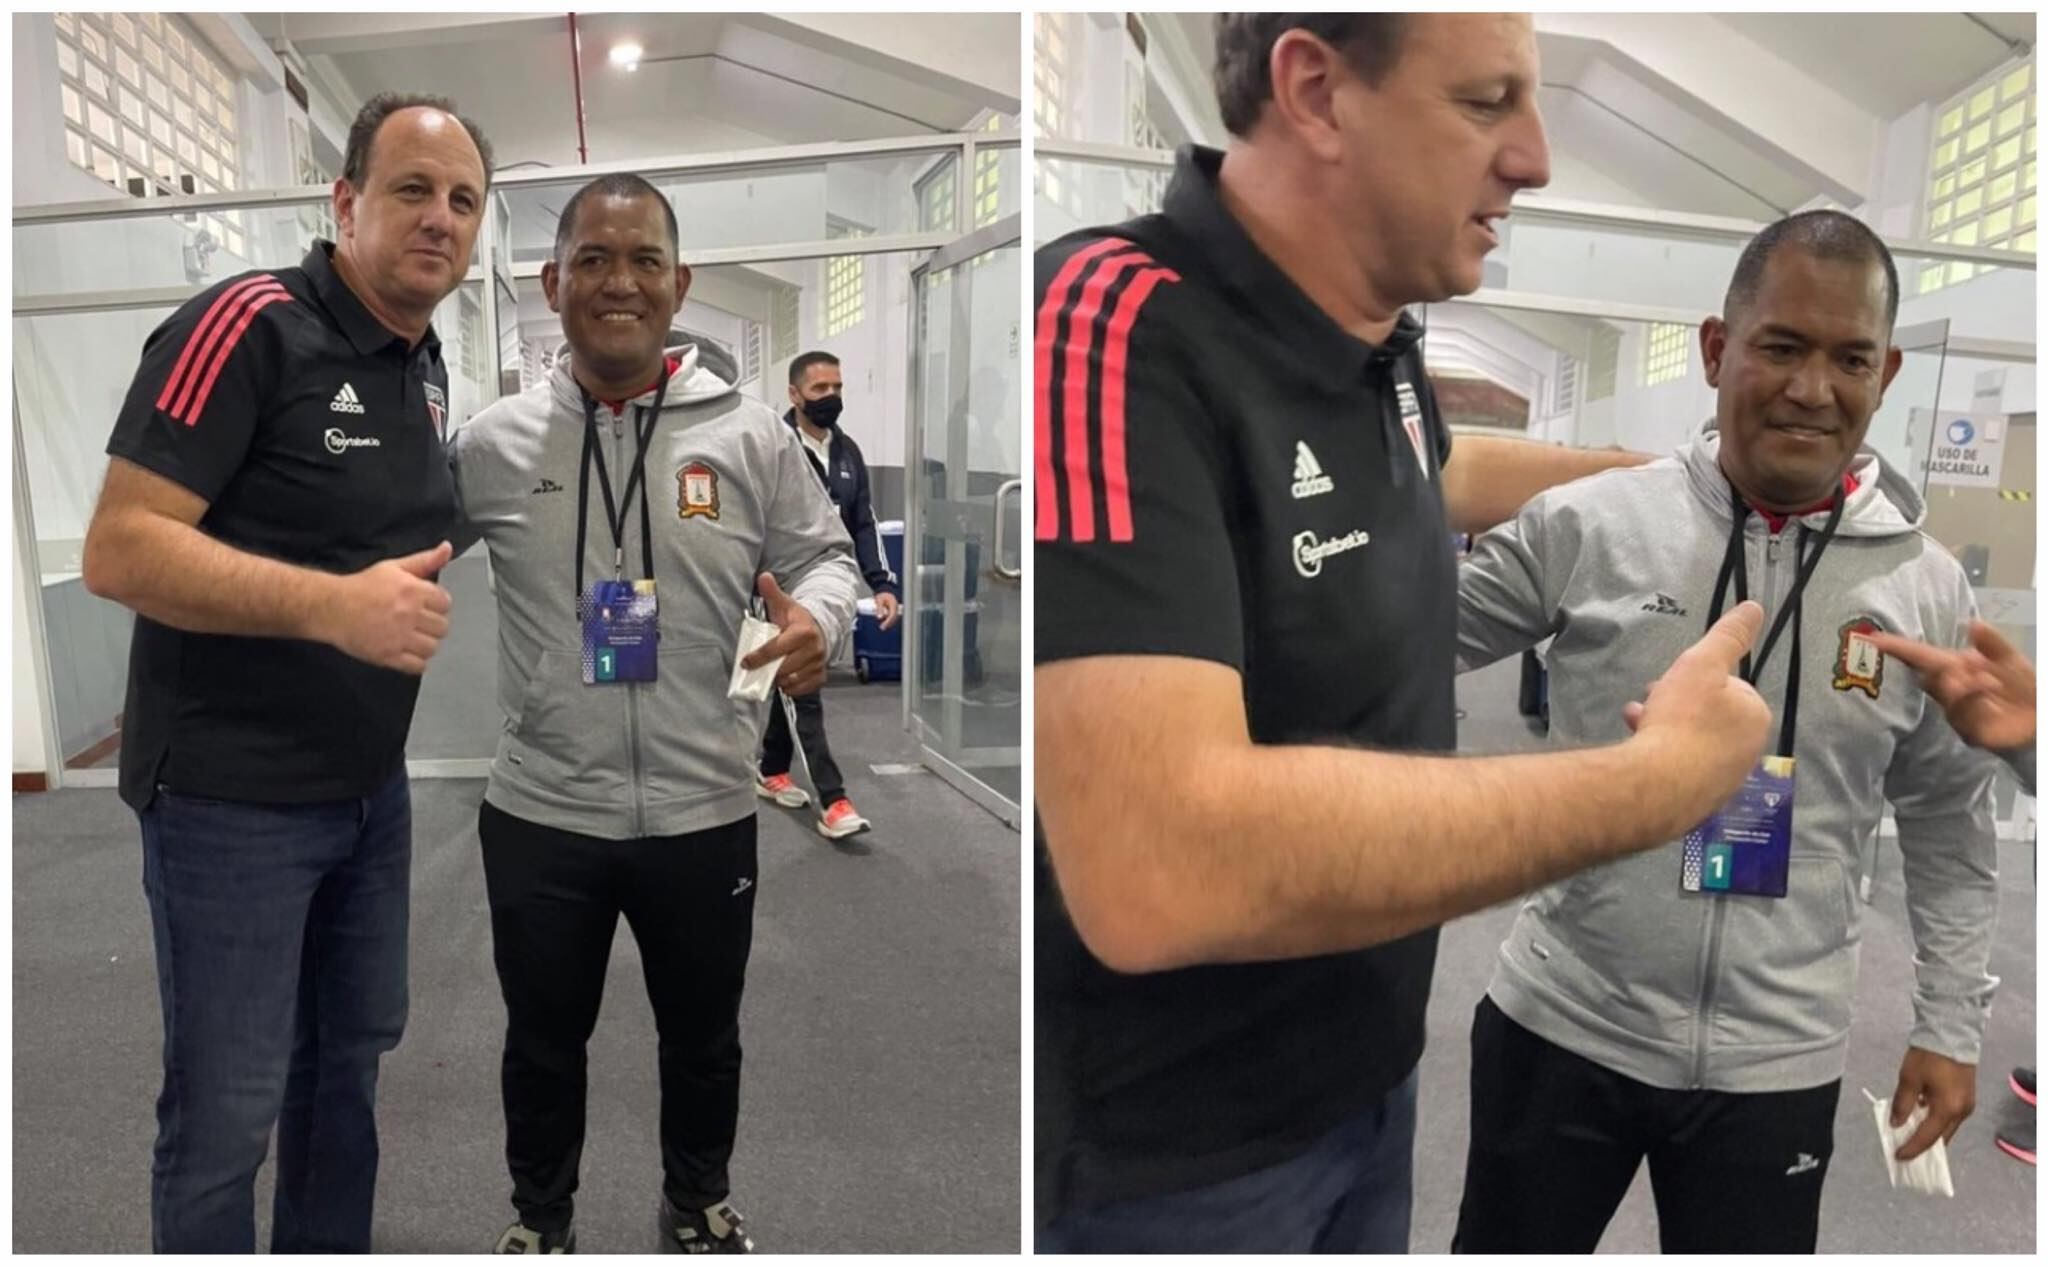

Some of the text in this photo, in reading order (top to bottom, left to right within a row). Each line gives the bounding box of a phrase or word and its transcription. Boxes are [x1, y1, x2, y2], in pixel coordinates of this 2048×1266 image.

[330, 401, 365, 414] adidas
[1937, 447, 1978, 461] USO DE
[1291, 475, 1334, 499] adidas
[1642, 604, 1688, 616] REAL
[600, 655, 610, 673] 1
[1711, 854, 1724, 879] 1
